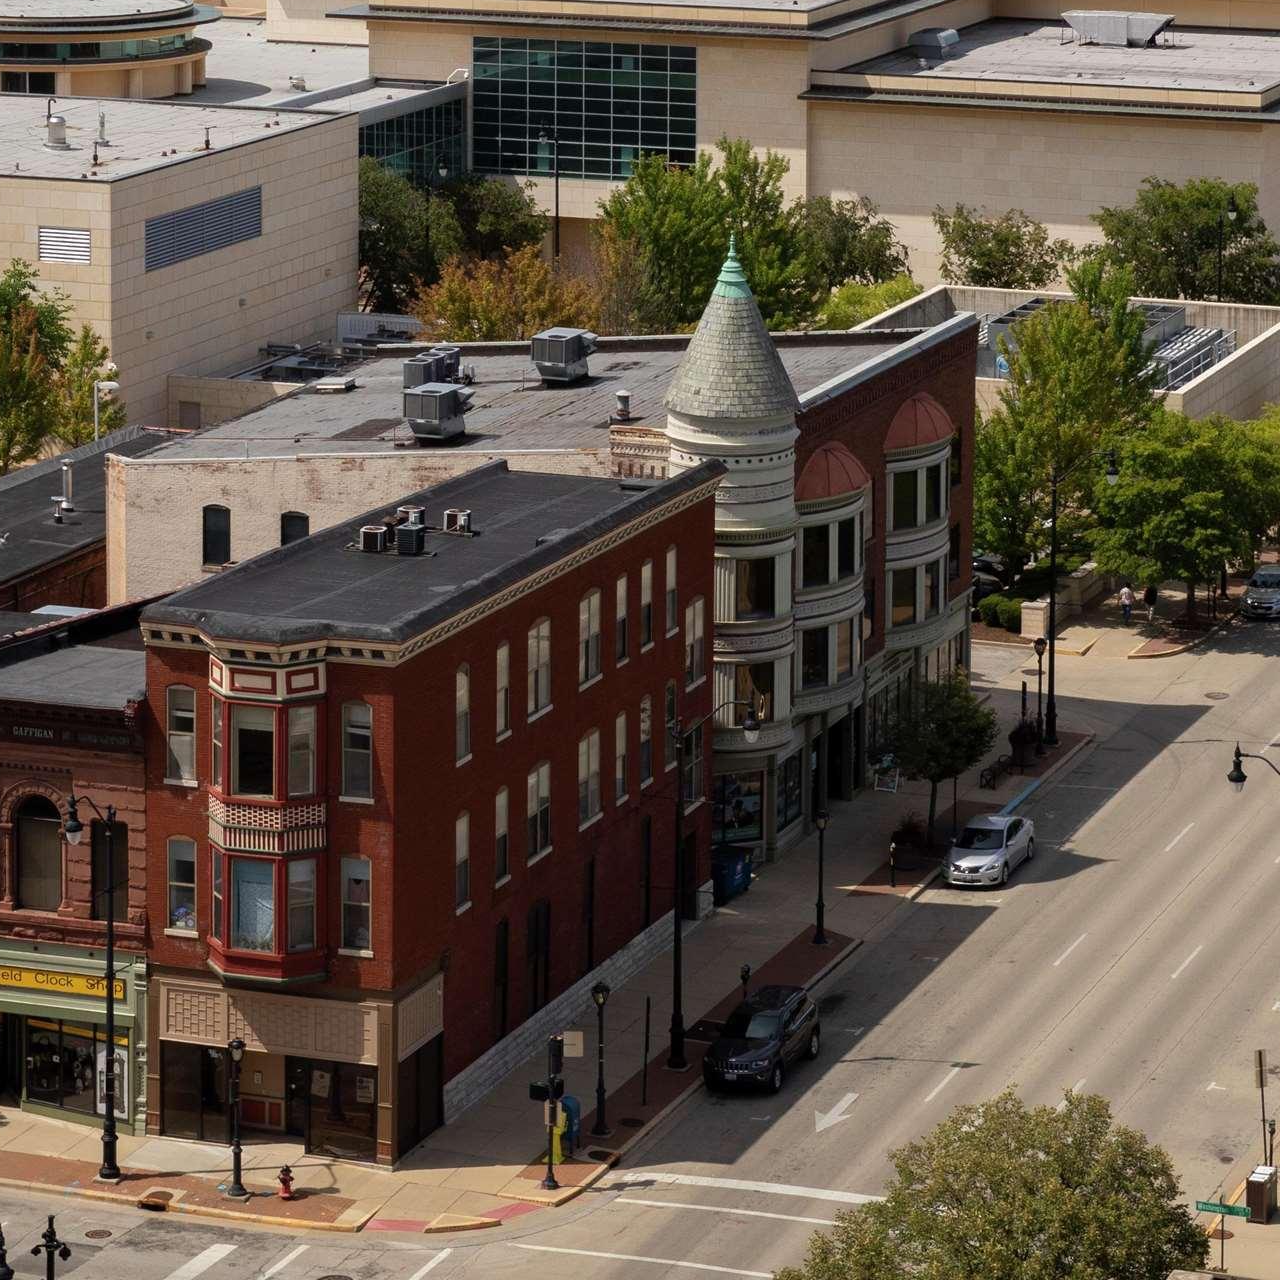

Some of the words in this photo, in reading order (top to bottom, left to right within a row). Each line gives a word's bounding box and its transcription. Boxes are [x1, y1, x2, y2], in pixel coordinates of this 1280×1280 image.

[12, 726, 54, 738] GAFFIGAN
[34, 971, 74, 988] Clock
[85, 978, 123, 995] Shp
